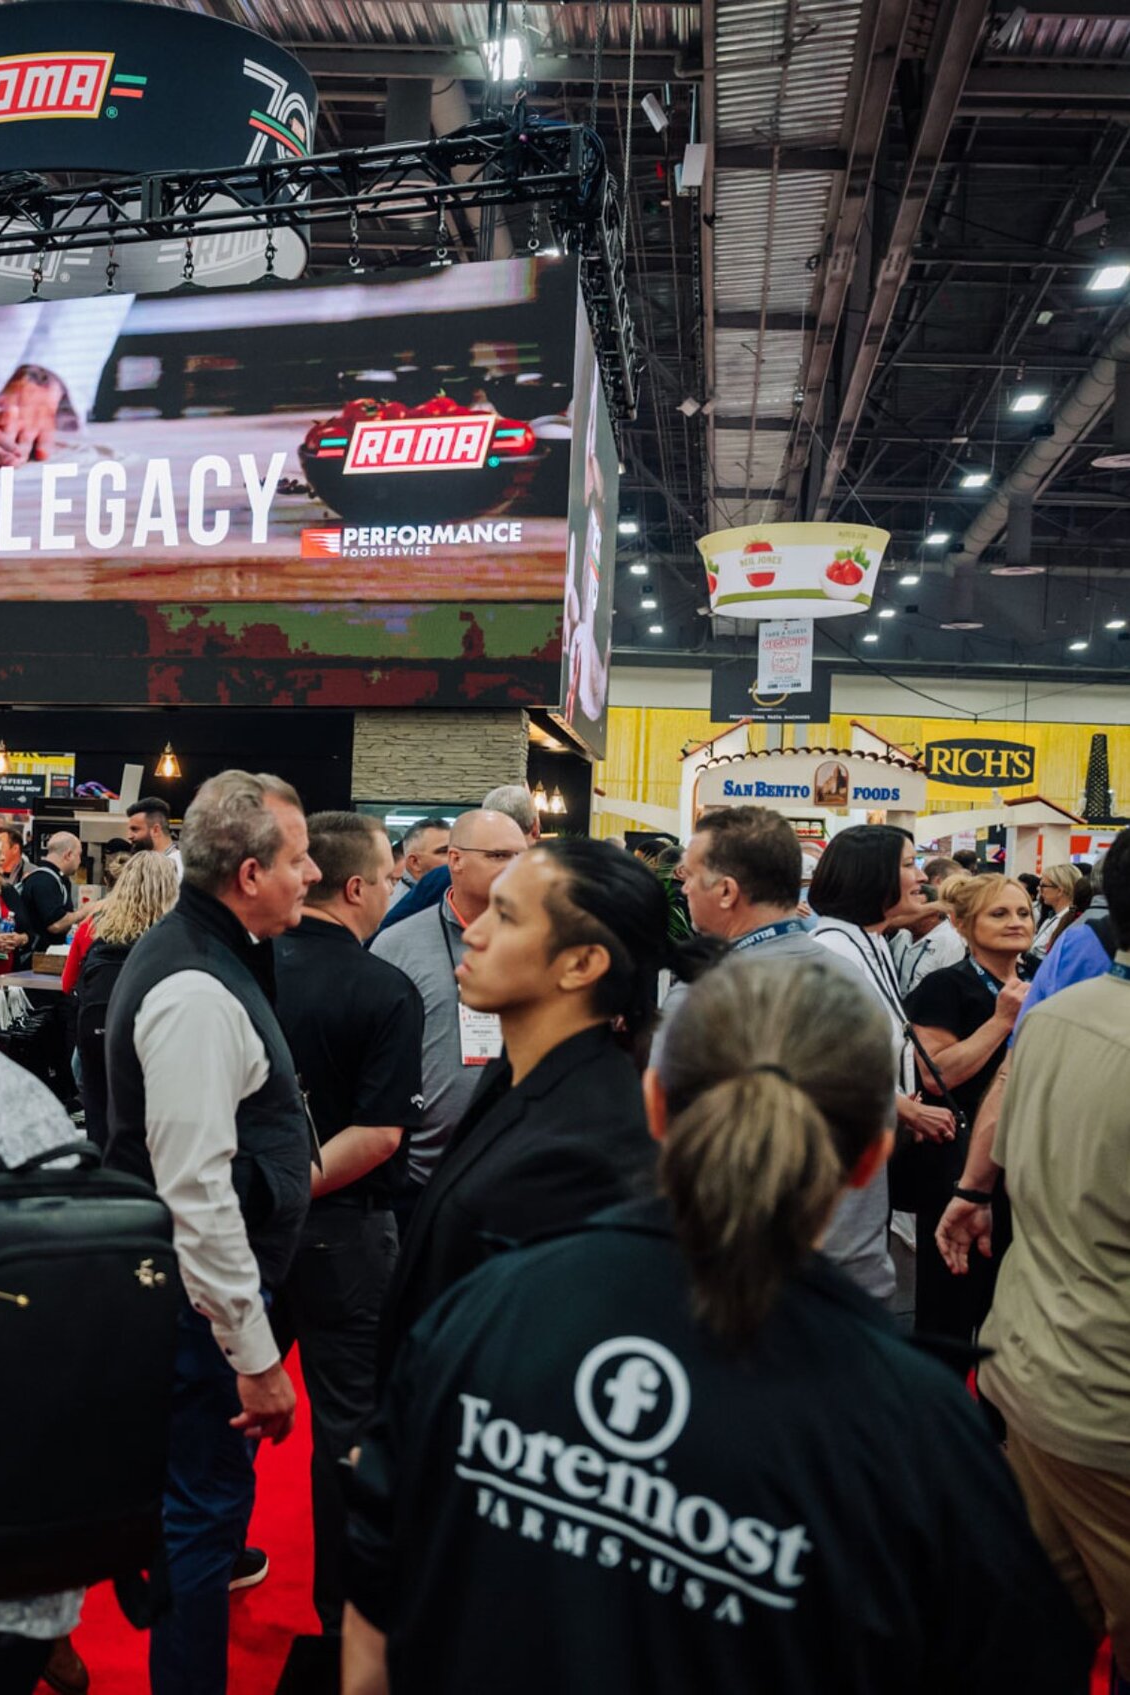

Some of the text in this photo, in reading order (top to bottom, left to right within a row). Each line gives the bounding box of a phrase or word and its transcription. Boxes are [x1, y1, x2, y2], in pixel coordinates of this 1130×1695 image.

[354, 425, 480, 464] ROMA
[343, 521, 522, 546] PERFORMANCE
[343, 546, 431, 558] FOODSERVICE
[930, 746, 1032, 779] RICH'S
[723, 780, 900, 800] SAN BENITO FOODS
[457, 1393, 812, 1586] Foremost
